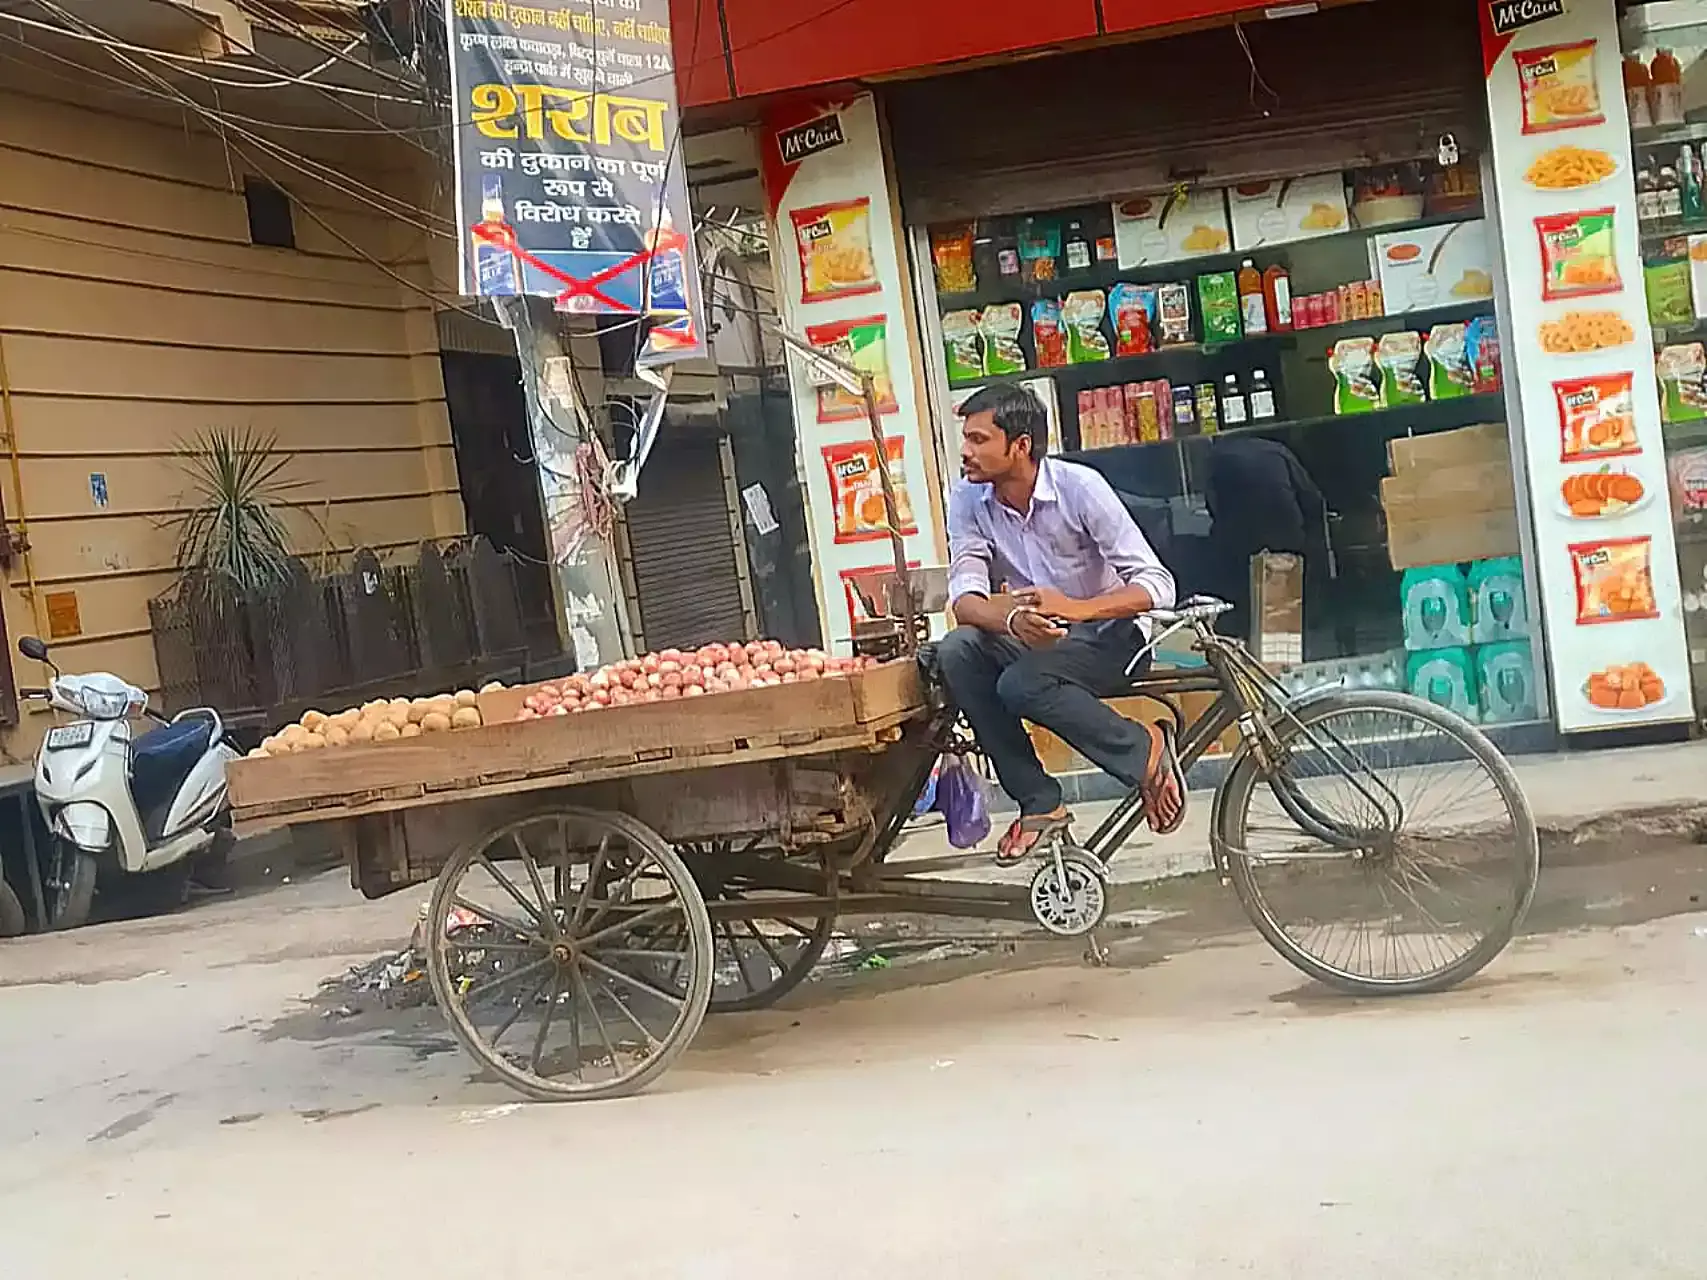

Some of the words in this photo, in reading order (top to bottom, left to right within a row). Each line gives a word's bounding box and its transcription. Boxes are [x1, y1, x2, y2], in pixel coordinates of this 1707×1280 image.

[1498, 0, 1561, 28] McCain
[471, 84, 668, 151] शराब
[785, 128, 842, 160] McCain
[479, 147, 515, 170] की
[520, 151, 591, 177] दुकान
[595, 155, 629, 177] का
[543, 178, 586, 198] रूप
[590, 178, 615, 198] से
[514, 202, 583, 223] विरोध
[586, 203, 642, 226] करते
